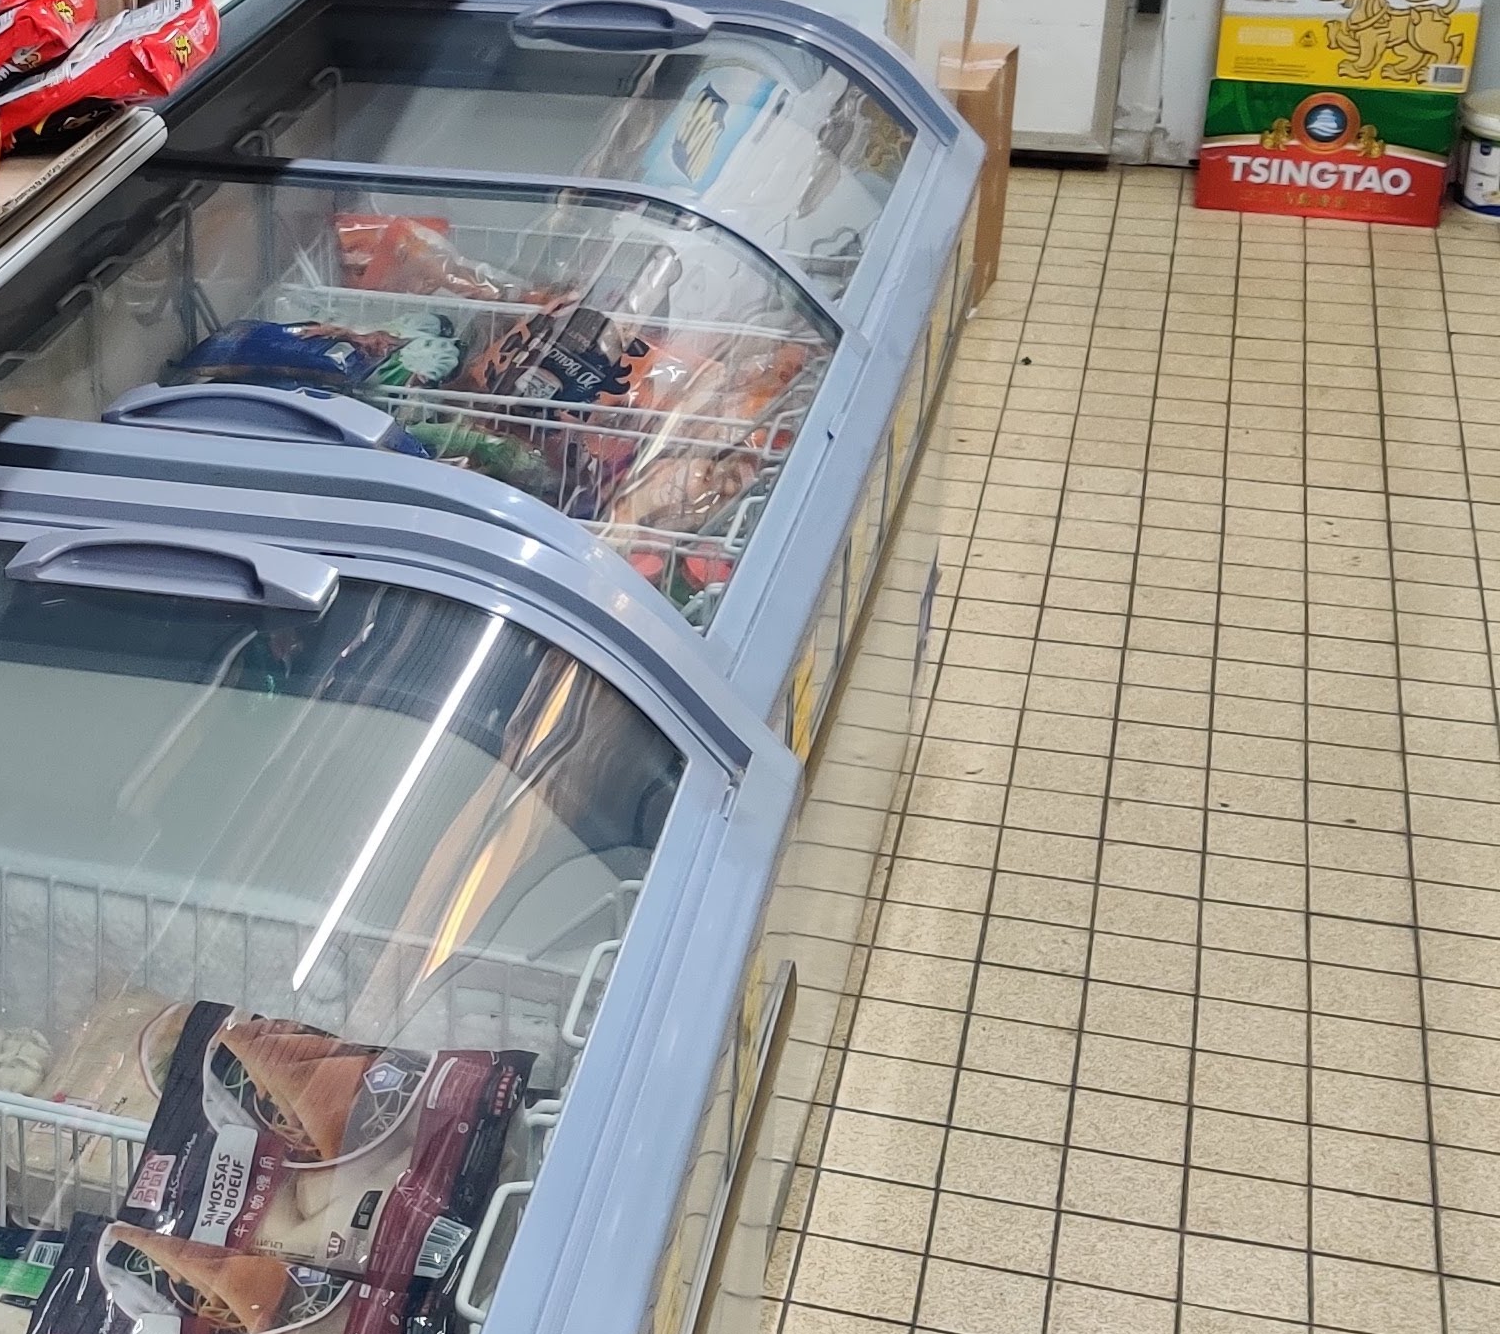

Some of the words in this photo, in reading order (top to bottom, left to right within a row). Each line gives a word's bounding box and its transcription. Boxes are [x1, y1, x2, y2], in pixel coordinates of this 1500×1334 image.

[1227, 155, 1412, 197] TSINGTAO
[201, 1153, 232, 1228] SAMOSSAS
[223, 1160, 246, 1212] BOEUF
[215, 1210, 232, 1226] AU
